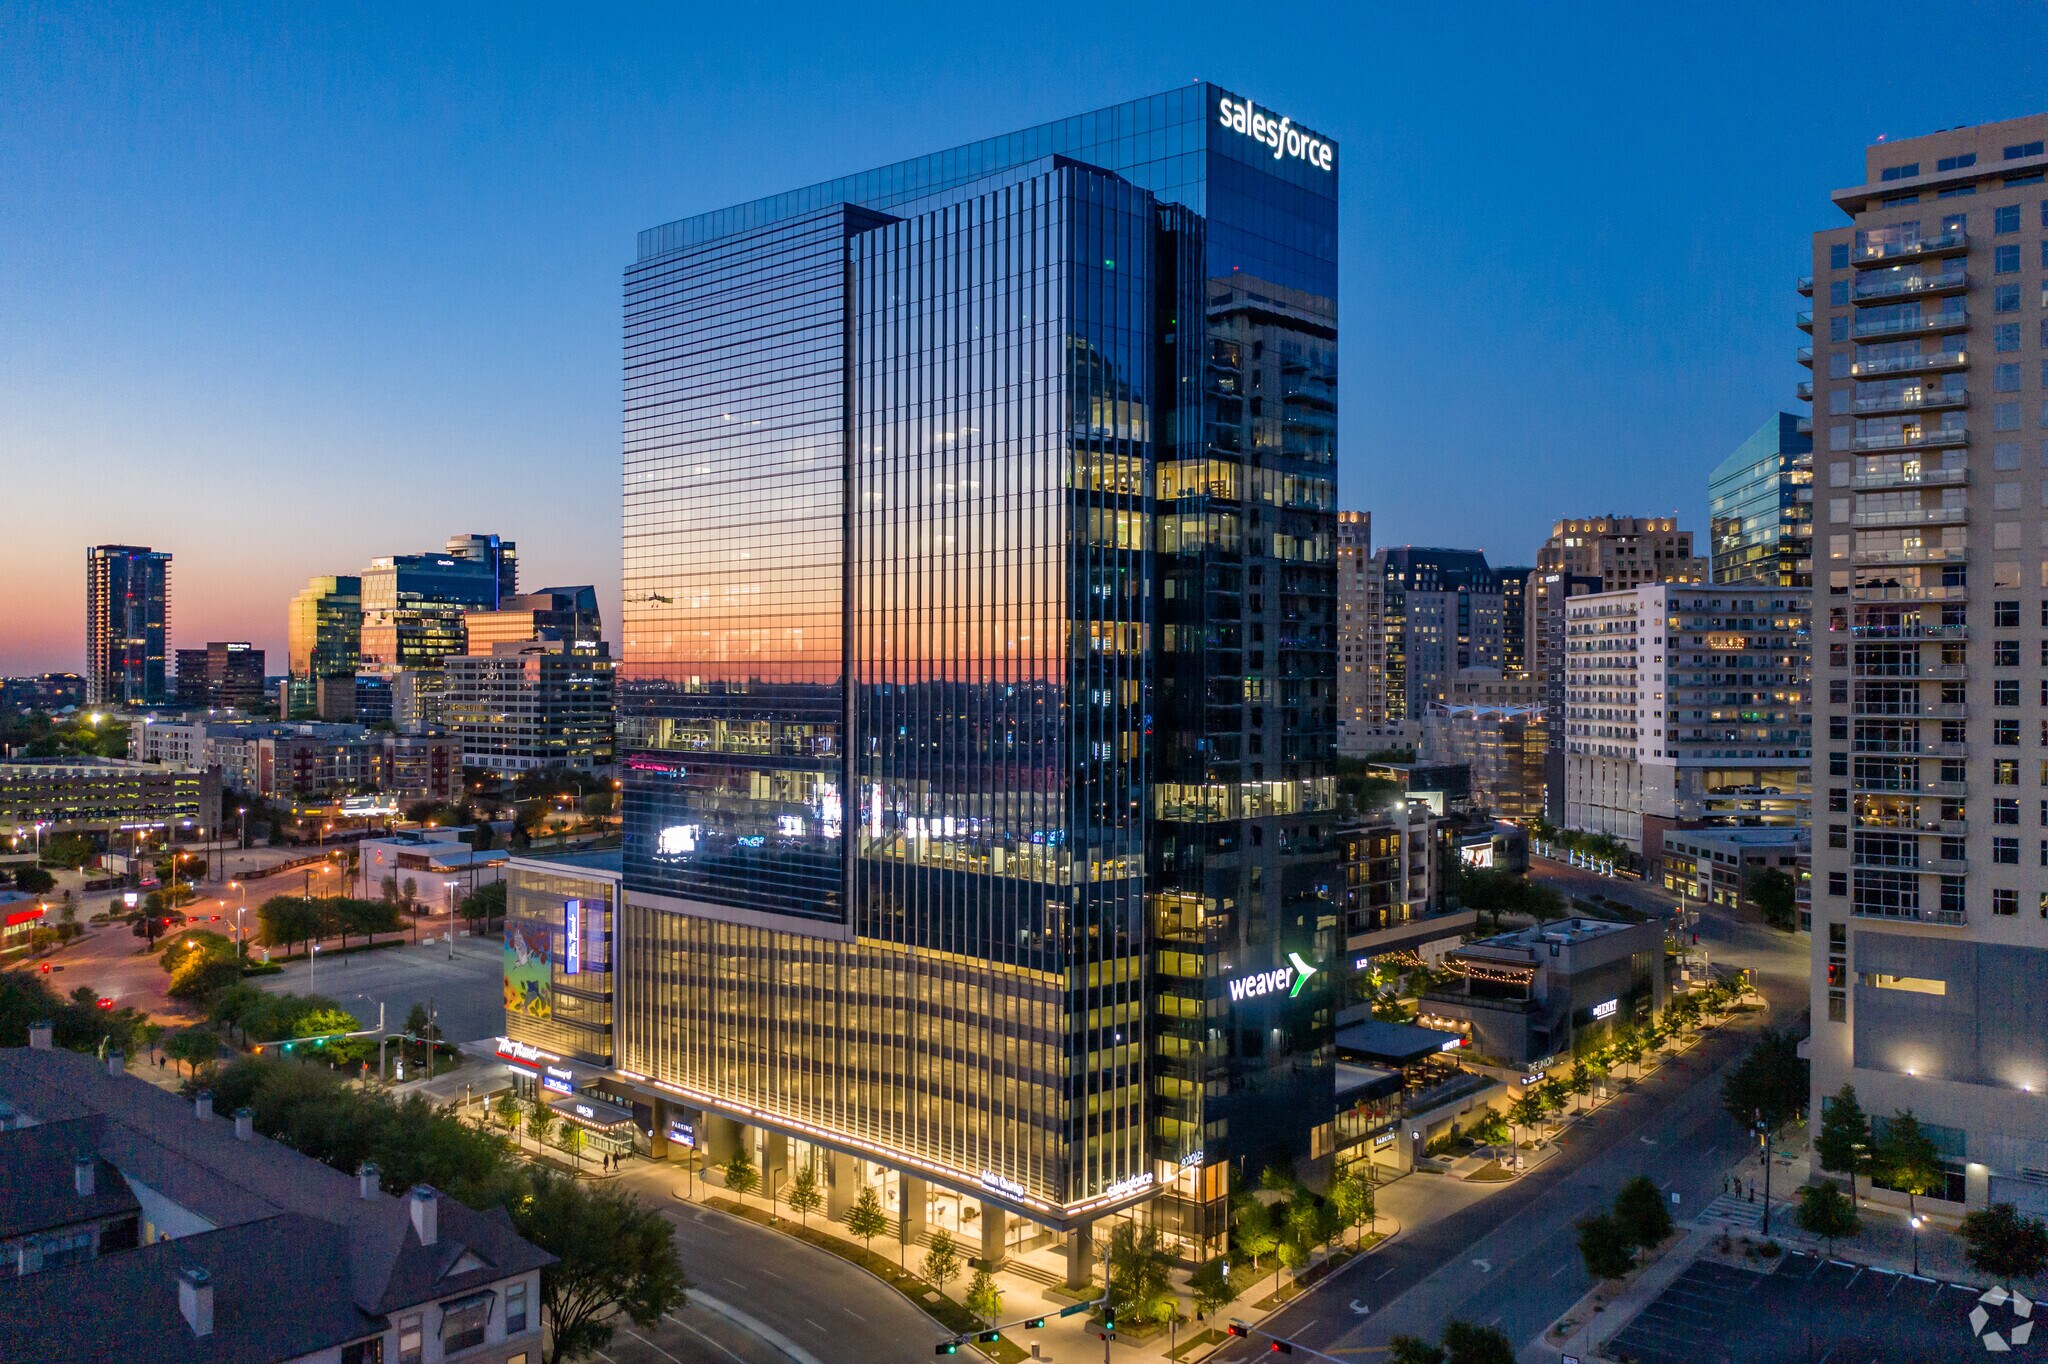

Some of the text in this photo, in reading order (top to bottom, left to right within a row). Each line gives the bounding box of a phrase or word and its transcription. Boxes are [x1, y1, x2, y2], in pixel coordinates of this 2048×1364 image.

[1219, 98, 1332, 171] salesforce
[1229, 966, 1294, 1001] weaver
[671, 1121, 693, 1133] PARKING
[1376, 1132, 1396, 1145] PARKING
[1107, 1172, 1153, 1197] salesforce
